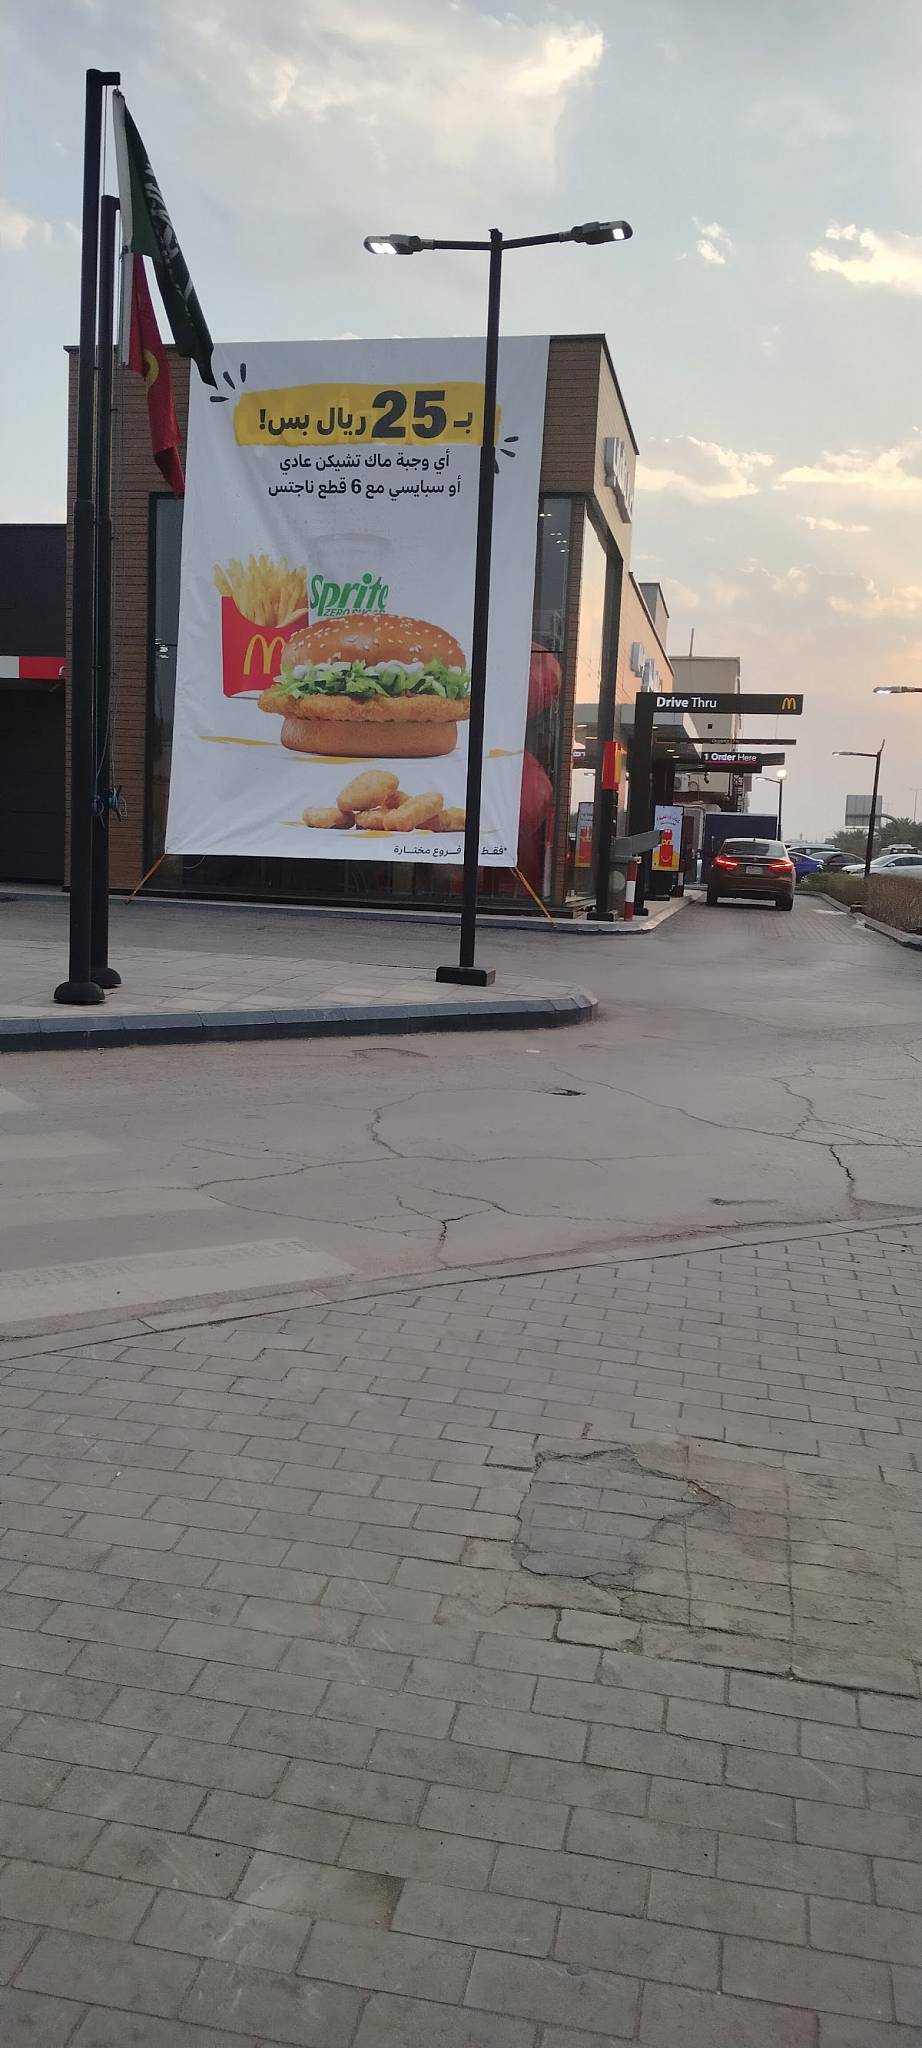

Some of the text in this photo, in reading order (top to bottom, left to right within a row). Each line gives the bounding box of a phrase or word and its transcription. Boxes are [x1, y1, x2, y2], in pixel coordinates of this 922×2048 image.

[259, 408, 310, 437] بس!
[317, 407, 367, 436] ريال
[371, 390, 448, 439] 25
[279, 448, 450, 475] أي وجبة ماك تشيكن عادي
[268, 474, 462, 502] أو سبايسي مع 6 قطع ناجتس
[310, 573, 389, 617] Sprite
[323, 608, 350, 617] ZERO
[656, 696, 717, 708] Drive Thru
[704, 753, 757, 762] 1 Order Here
